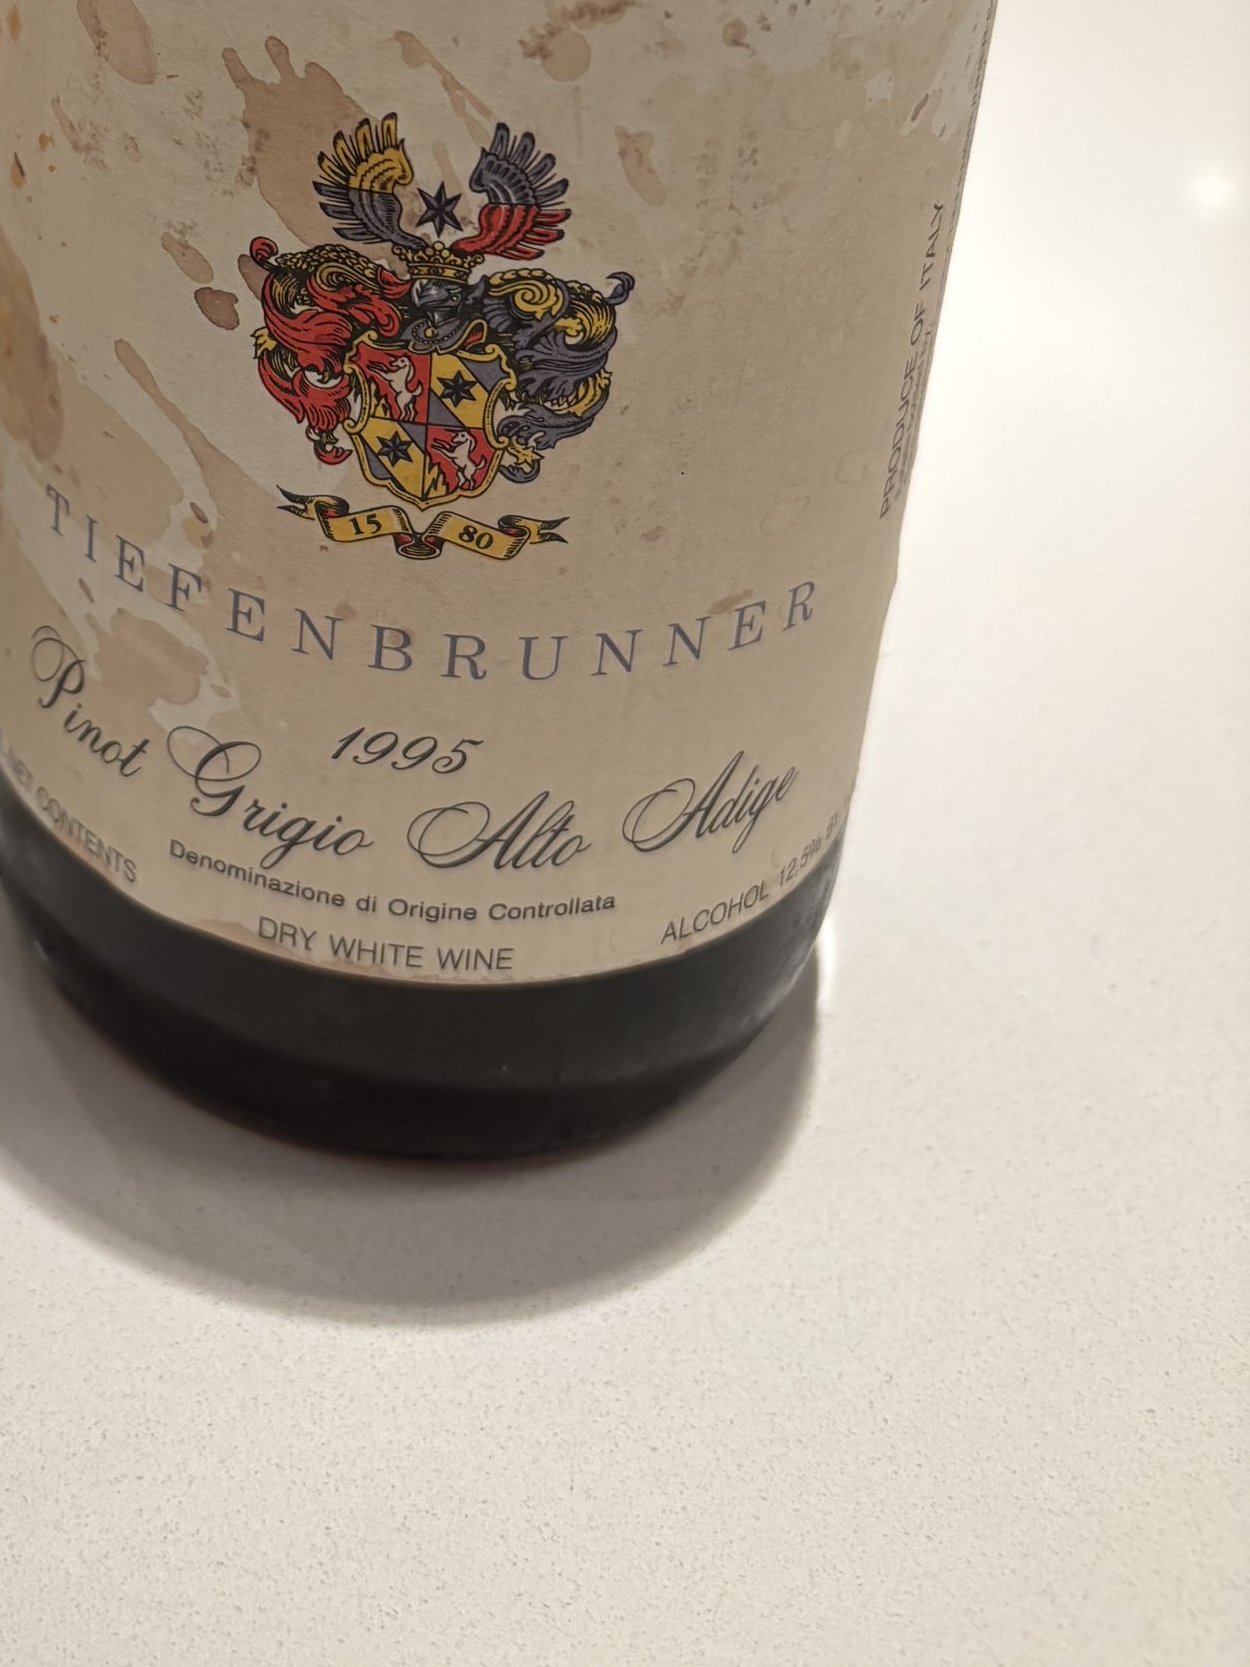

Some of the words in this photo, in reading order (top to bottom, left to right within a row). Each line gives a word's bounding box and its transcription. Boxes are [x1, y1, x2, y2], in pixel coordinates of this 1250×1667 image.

[879, 350, 918, 519] PRODUCE
[910, 300, 926, 346] OF
[918, 203, 944, 292] ITALY
[348, 513, 383, 535] 15
[458, 524, 494, 550] 80
[46, 483, 816, 681] TIEFENBRUNNER
[30, 624, 151, 778] Pinot
[166, 725, 375, 869] Grigio
[407, 790, 592, 870] Alto
[621, 750, 799, 855] Adige
[330, 726, 484, 774] 1995
[36, 786, 137, 883] CONTENTS
[169, 838, 346, 908] Denominazione
[355, 894, 377, 914] di
[387, 897, 478, 923] Origine
[487, 893, 616, 922] Controllata
[661, 880, 770, 945] ALCOHOL
[257, 915, 317, 951] DRY
[329, 934, 424, 969] WHITE
[437, 947, 514, 971] WINE
